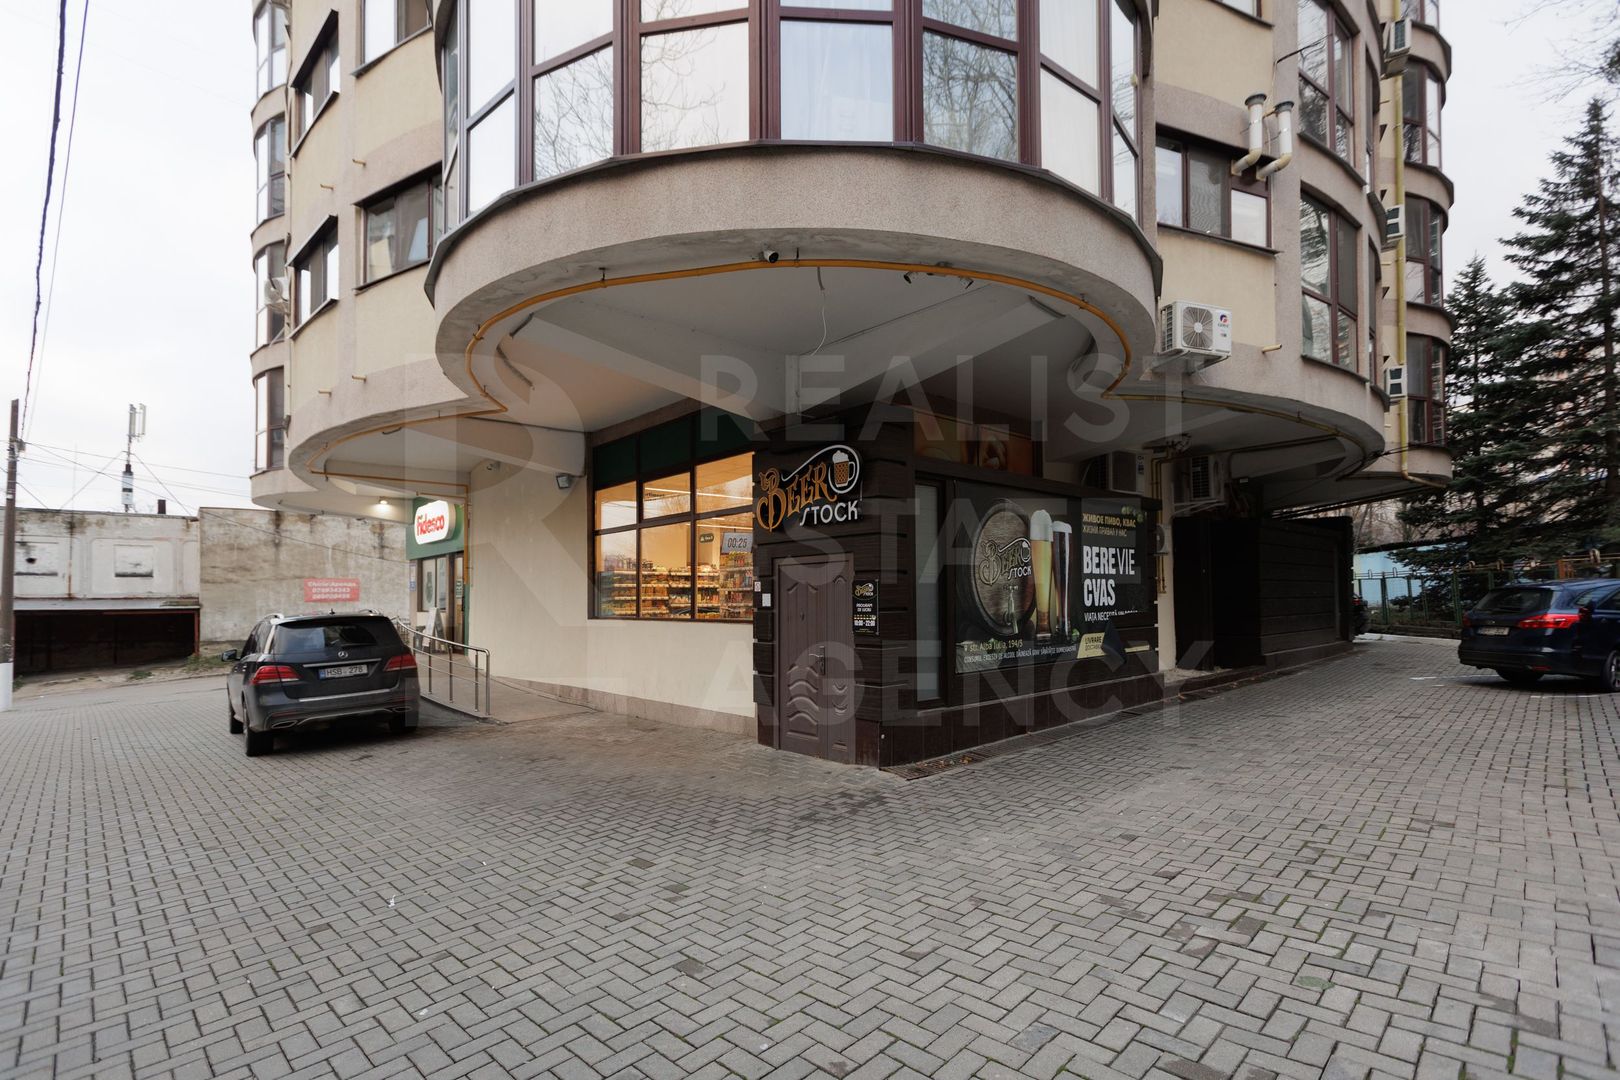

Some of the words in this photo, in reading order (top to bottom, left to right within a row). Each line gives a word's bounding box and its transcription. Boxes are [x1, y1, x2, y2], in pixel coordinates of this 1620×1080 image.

[757, 461, 838, 533] BEER
[800, 500, 859, 526] STOCK
[1083, 545, 1116, 575] BERE
[1116, 548, 1135, 575] VIE
[1083, 578, 1116, 607] CVAS
